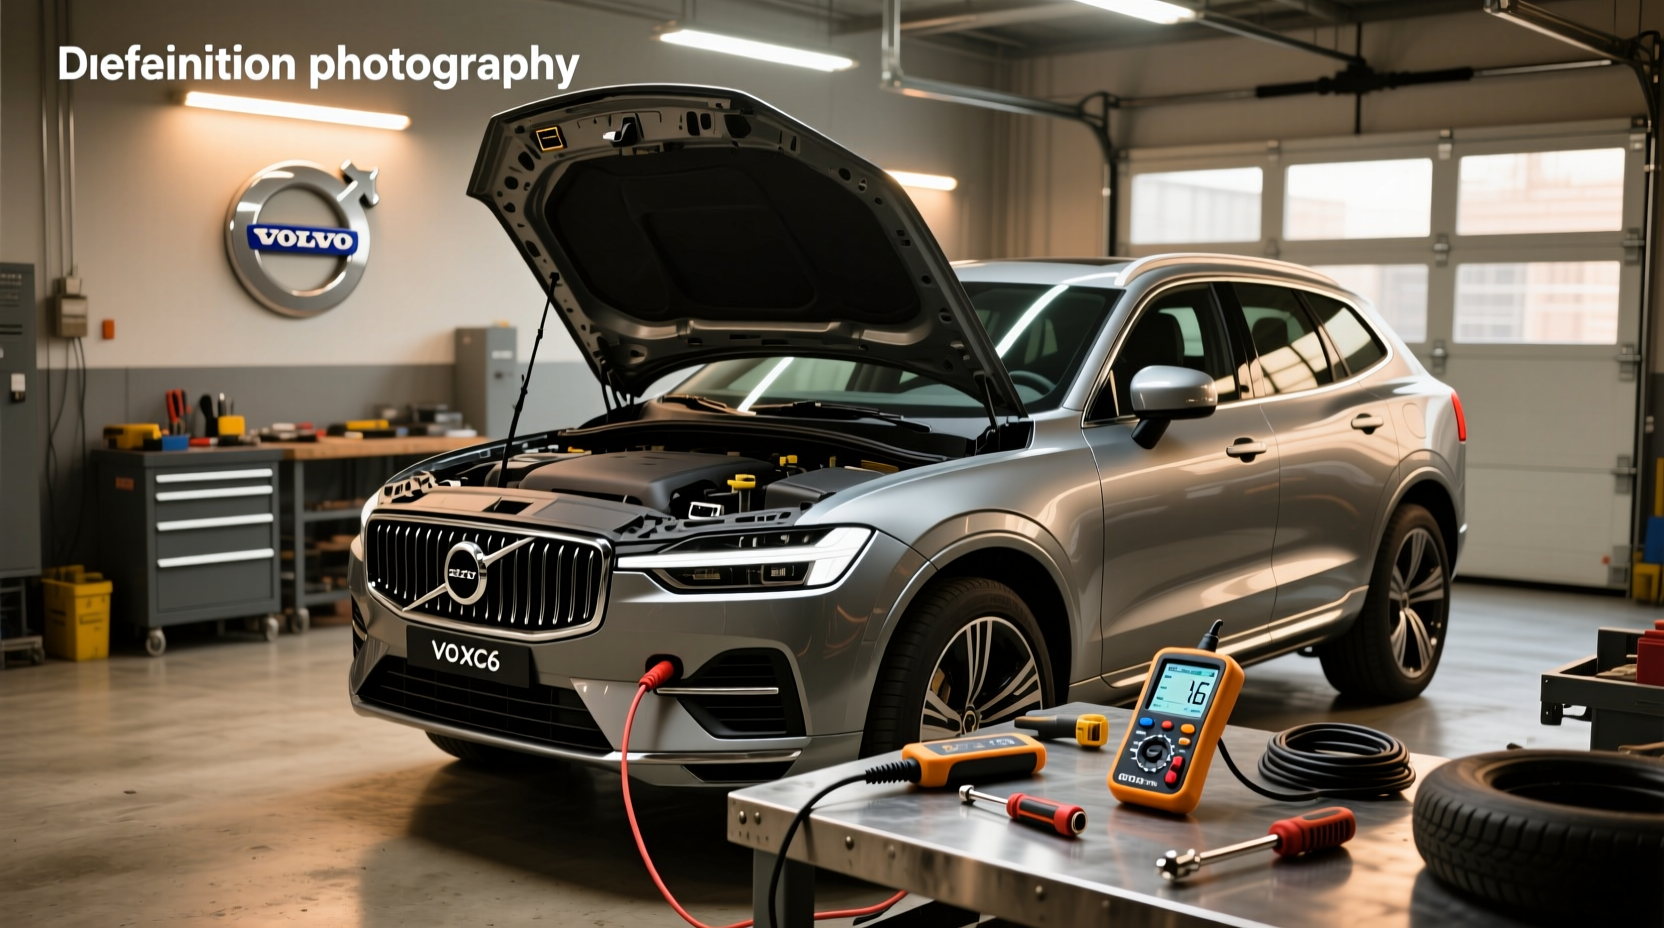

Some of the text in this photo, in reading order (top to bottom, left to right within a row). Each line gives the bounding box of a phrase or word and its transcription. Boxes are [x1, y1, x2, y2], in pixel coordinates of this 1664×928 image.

[253, 228, 353, 250] VOLVO
[431, 639, 500, 672] VOXC6
[1187, 680, 1210, 705] 16
